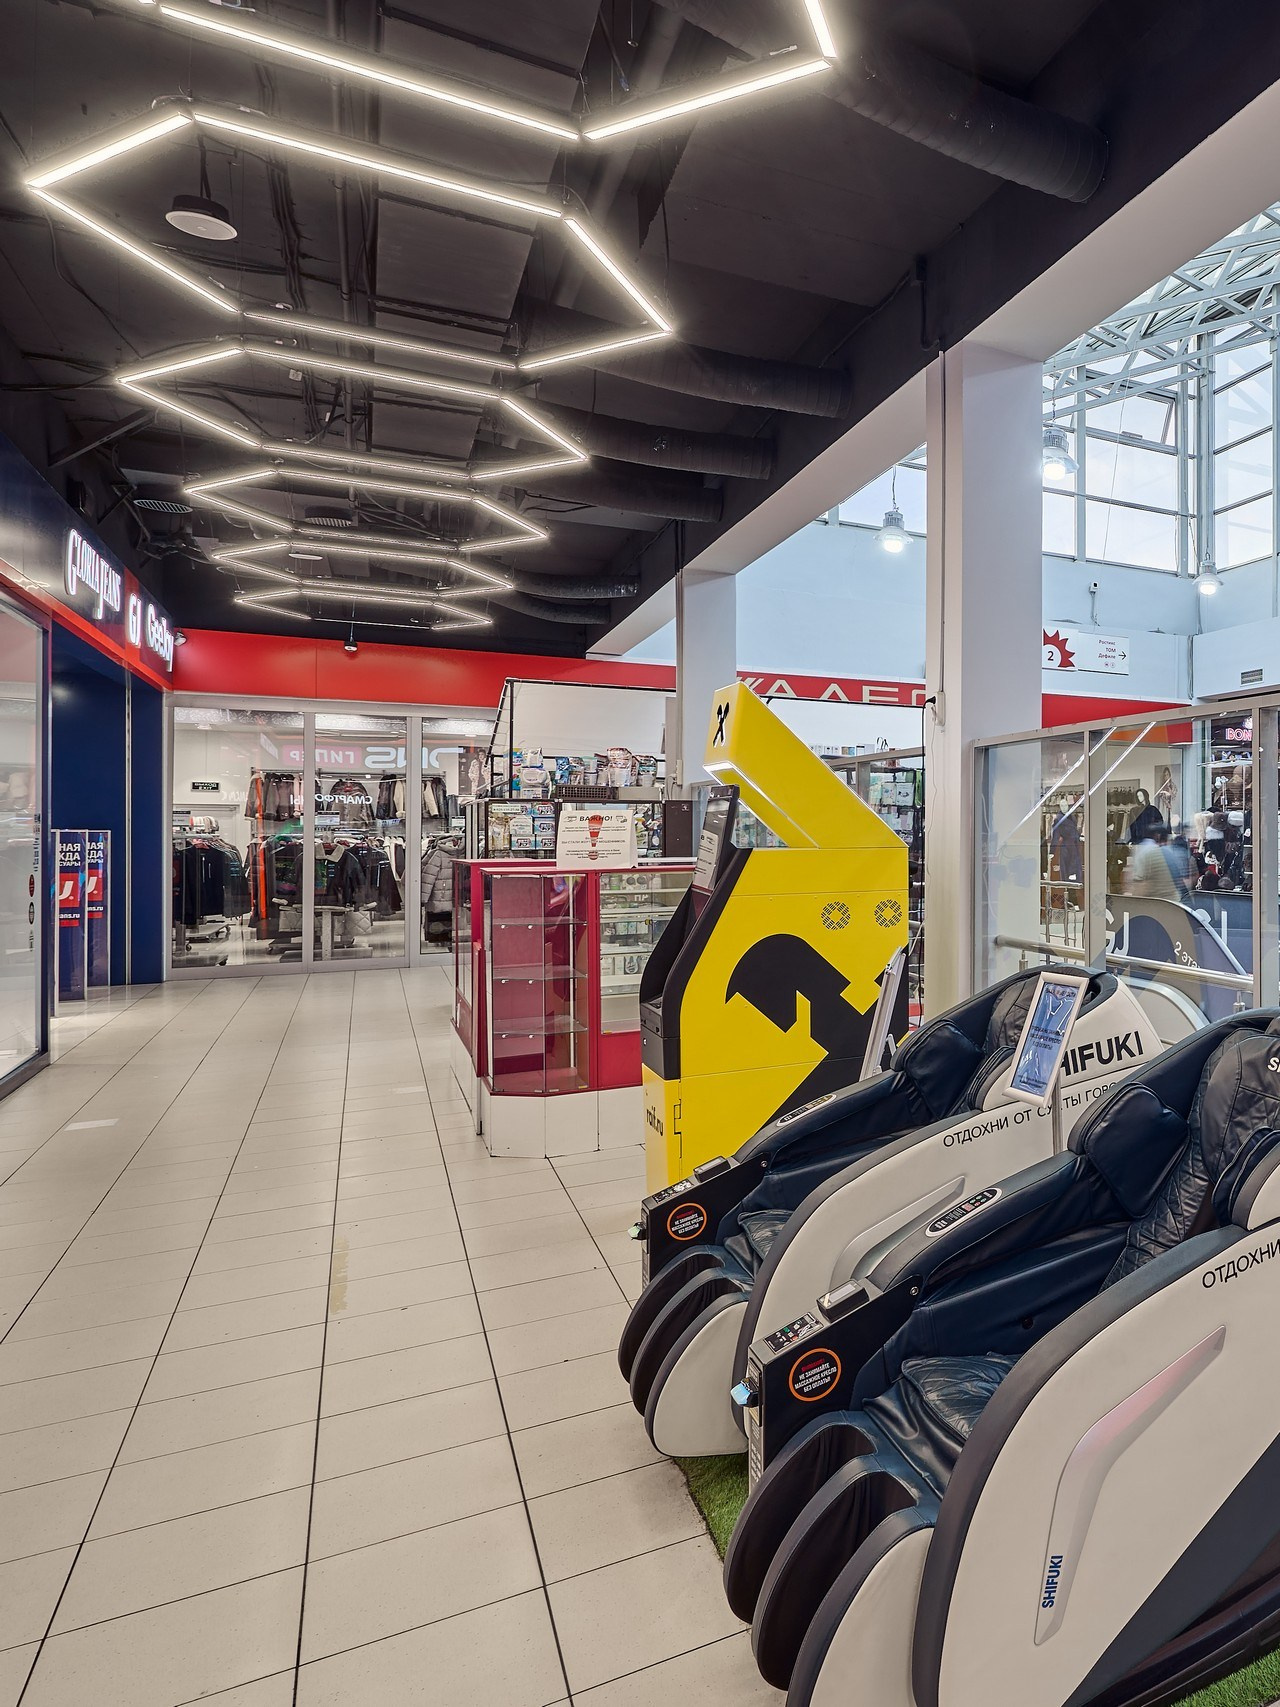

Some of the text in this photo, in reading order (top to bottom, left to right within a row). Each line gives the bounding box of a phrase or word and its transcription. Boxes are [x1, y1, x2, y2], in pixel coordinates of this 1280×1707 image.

[67, 529, 121, 620] GLORIA JEANS
[1047, 650, 1054, 661] 2
[1174, 941, 1200, 969] 2 эта
[1060, 1030, 1144, 1077] HIFUKI
[943, 1116, 1009, 1148] ОТДОХНИ
[1013, 1109, 1032, 1124] ОТ
[1037, 1093, 1081, 1117] СУТЫ
[794, 1366, 838, 1390] МАССАЖНОЕ КРЕСЛО
[805, 1362, 830, 1378] ЗАНИМАЙТЕ
[803, 1385, 812, 1393] БЕЗ
[1041, 1555, 1064, 1609] SHIFUKI
